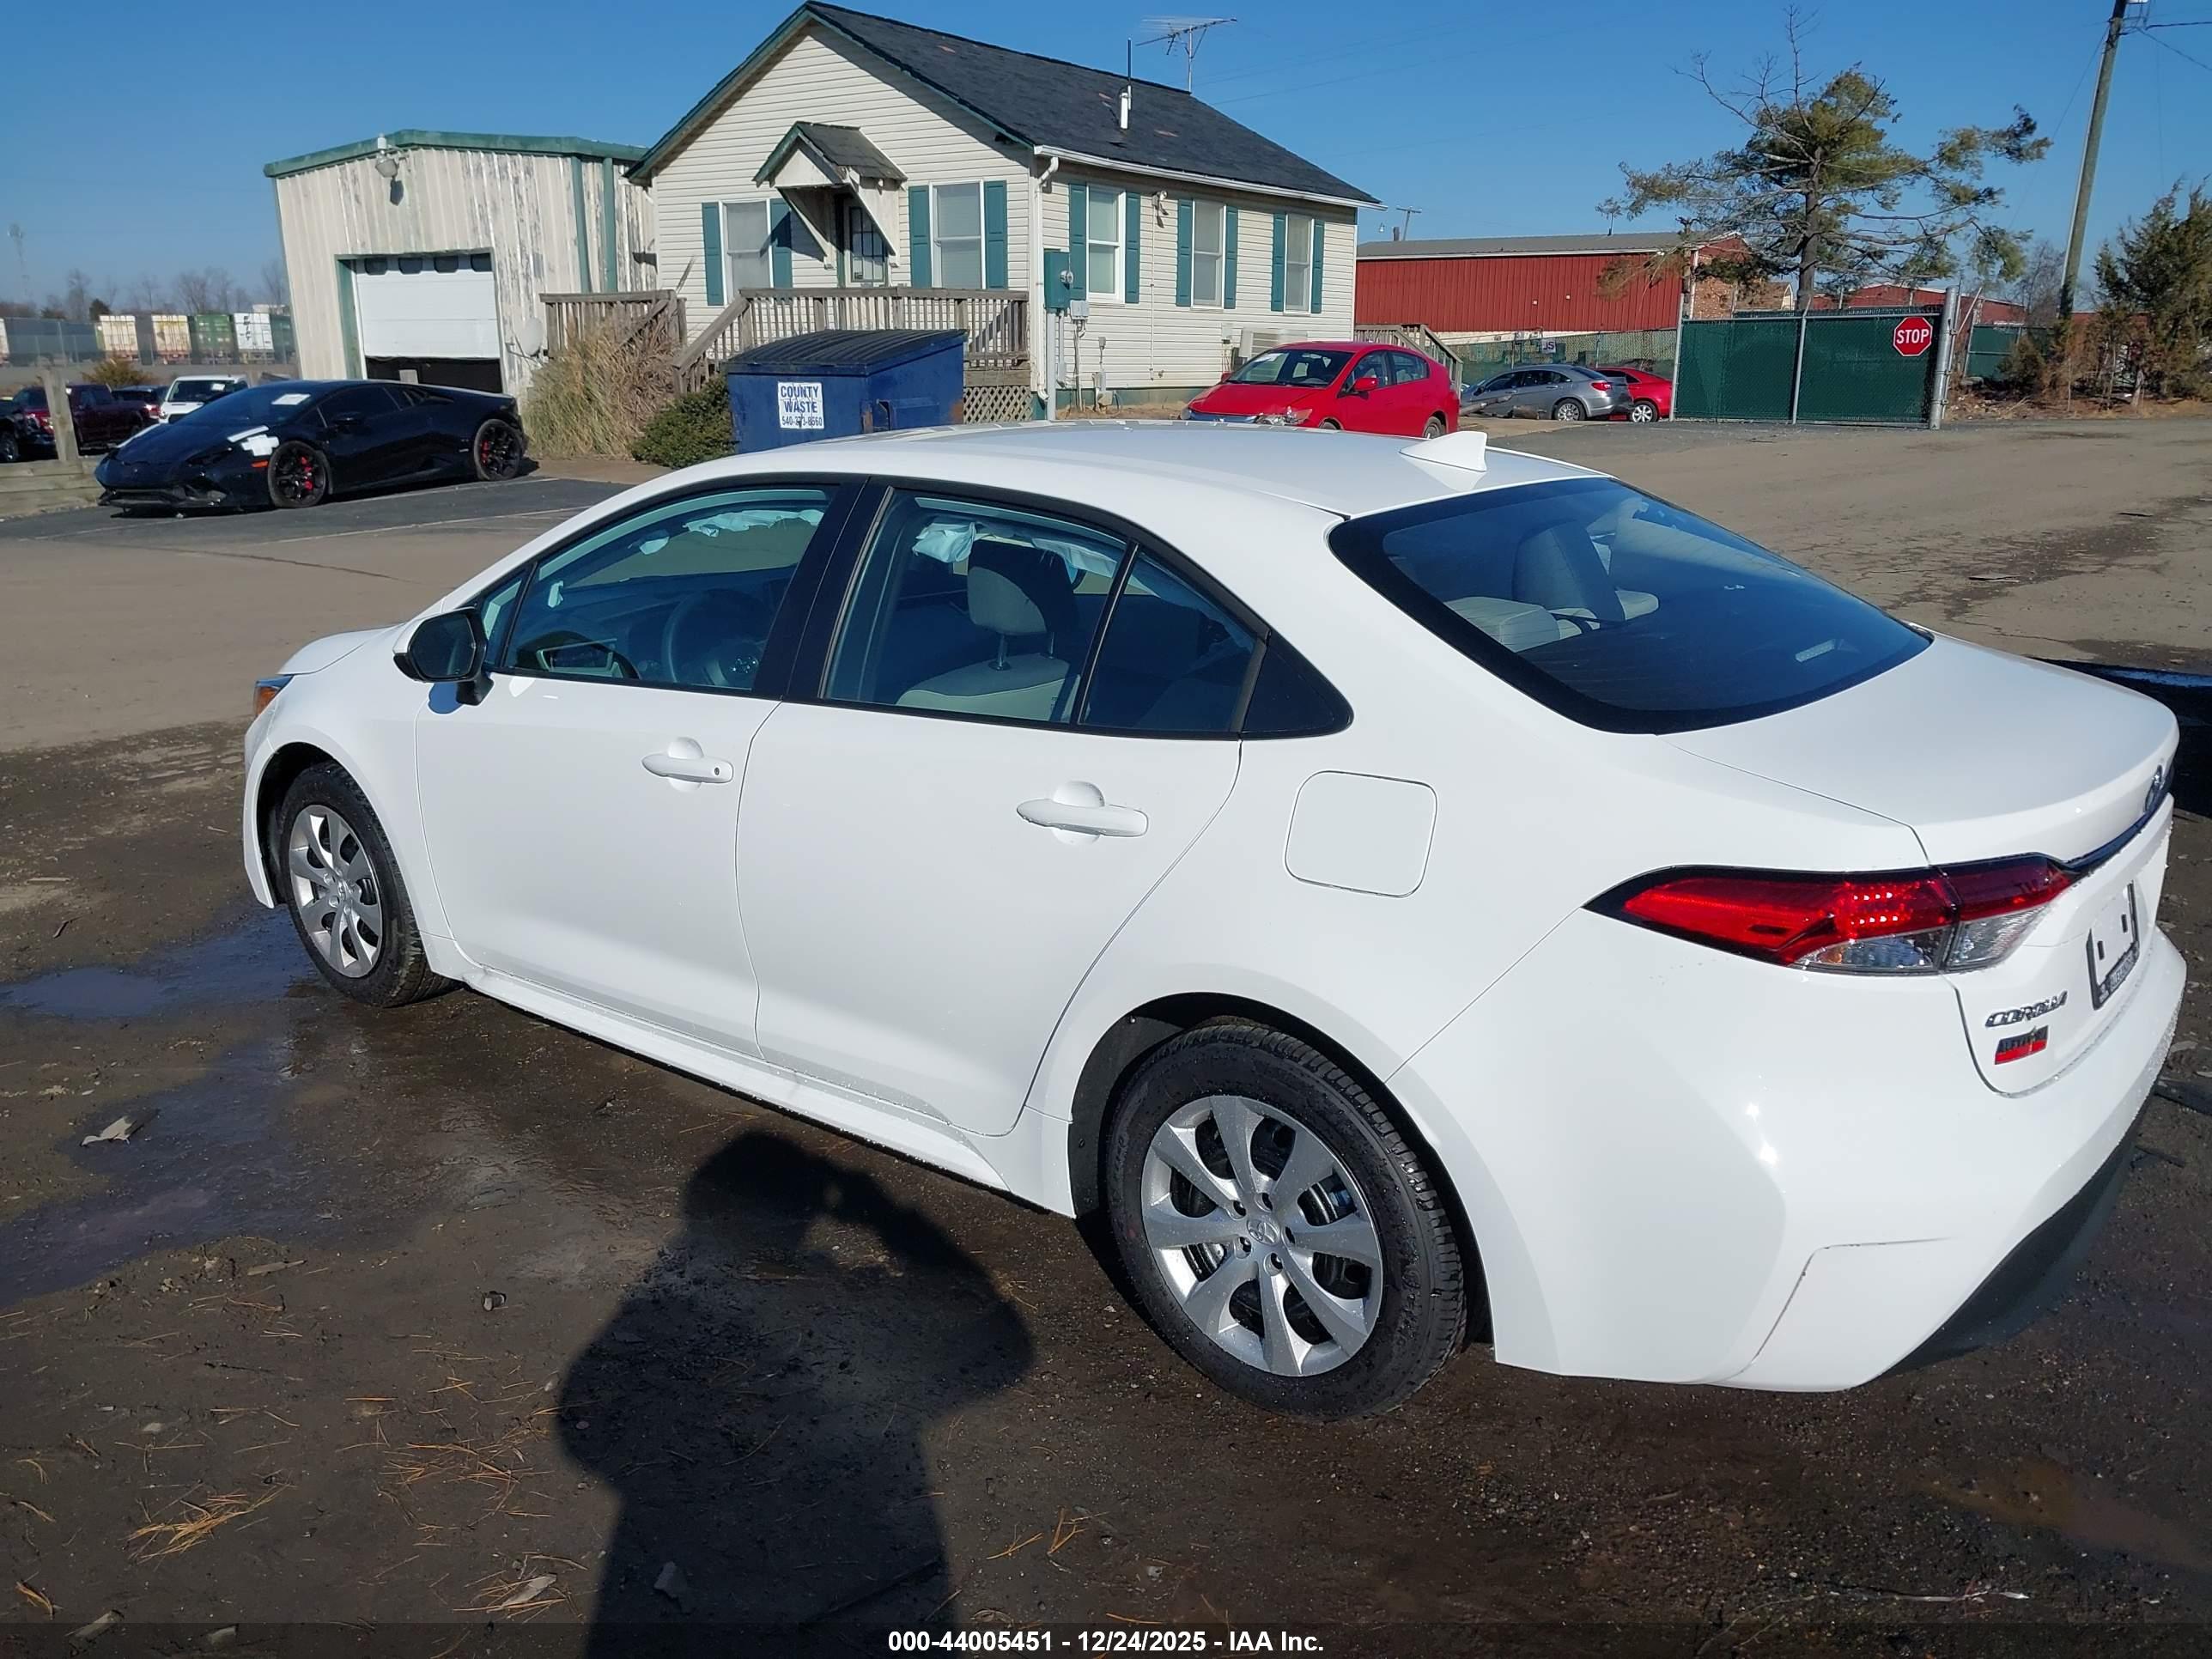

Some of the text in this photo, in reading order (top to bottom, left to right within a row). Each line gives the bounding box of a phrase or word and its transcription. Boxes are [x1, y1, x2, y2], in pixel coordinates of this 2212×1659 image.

[1896, 329, 1929, 344] STOP
[781, 386, 818, 398] COUNTY
[784, 401, 817, 413] WASTE
[1984, 990, 2068, 1028] COROLLA
